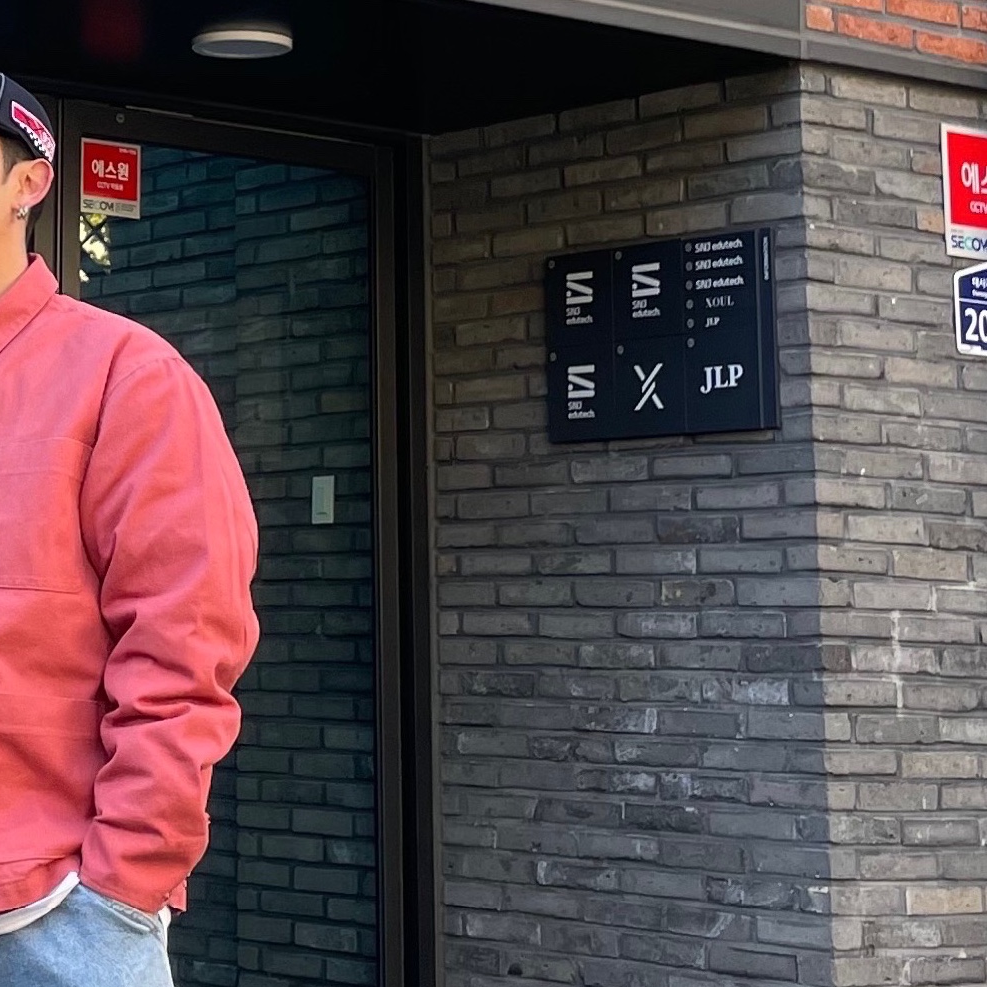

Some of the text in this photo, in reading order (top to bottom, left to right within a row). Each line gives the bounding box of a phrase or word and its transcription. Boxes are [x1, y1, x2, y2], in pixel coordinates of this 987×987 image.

[91, 159, 129, 181] 에스원
[711, 238, 743, 251] edutech
[711, 255, 744, 269] edutech
[712, 275, 745, 288] edutech
[705, 317, 720, 328] JLP
[700, 364, 743, 394] JLP
